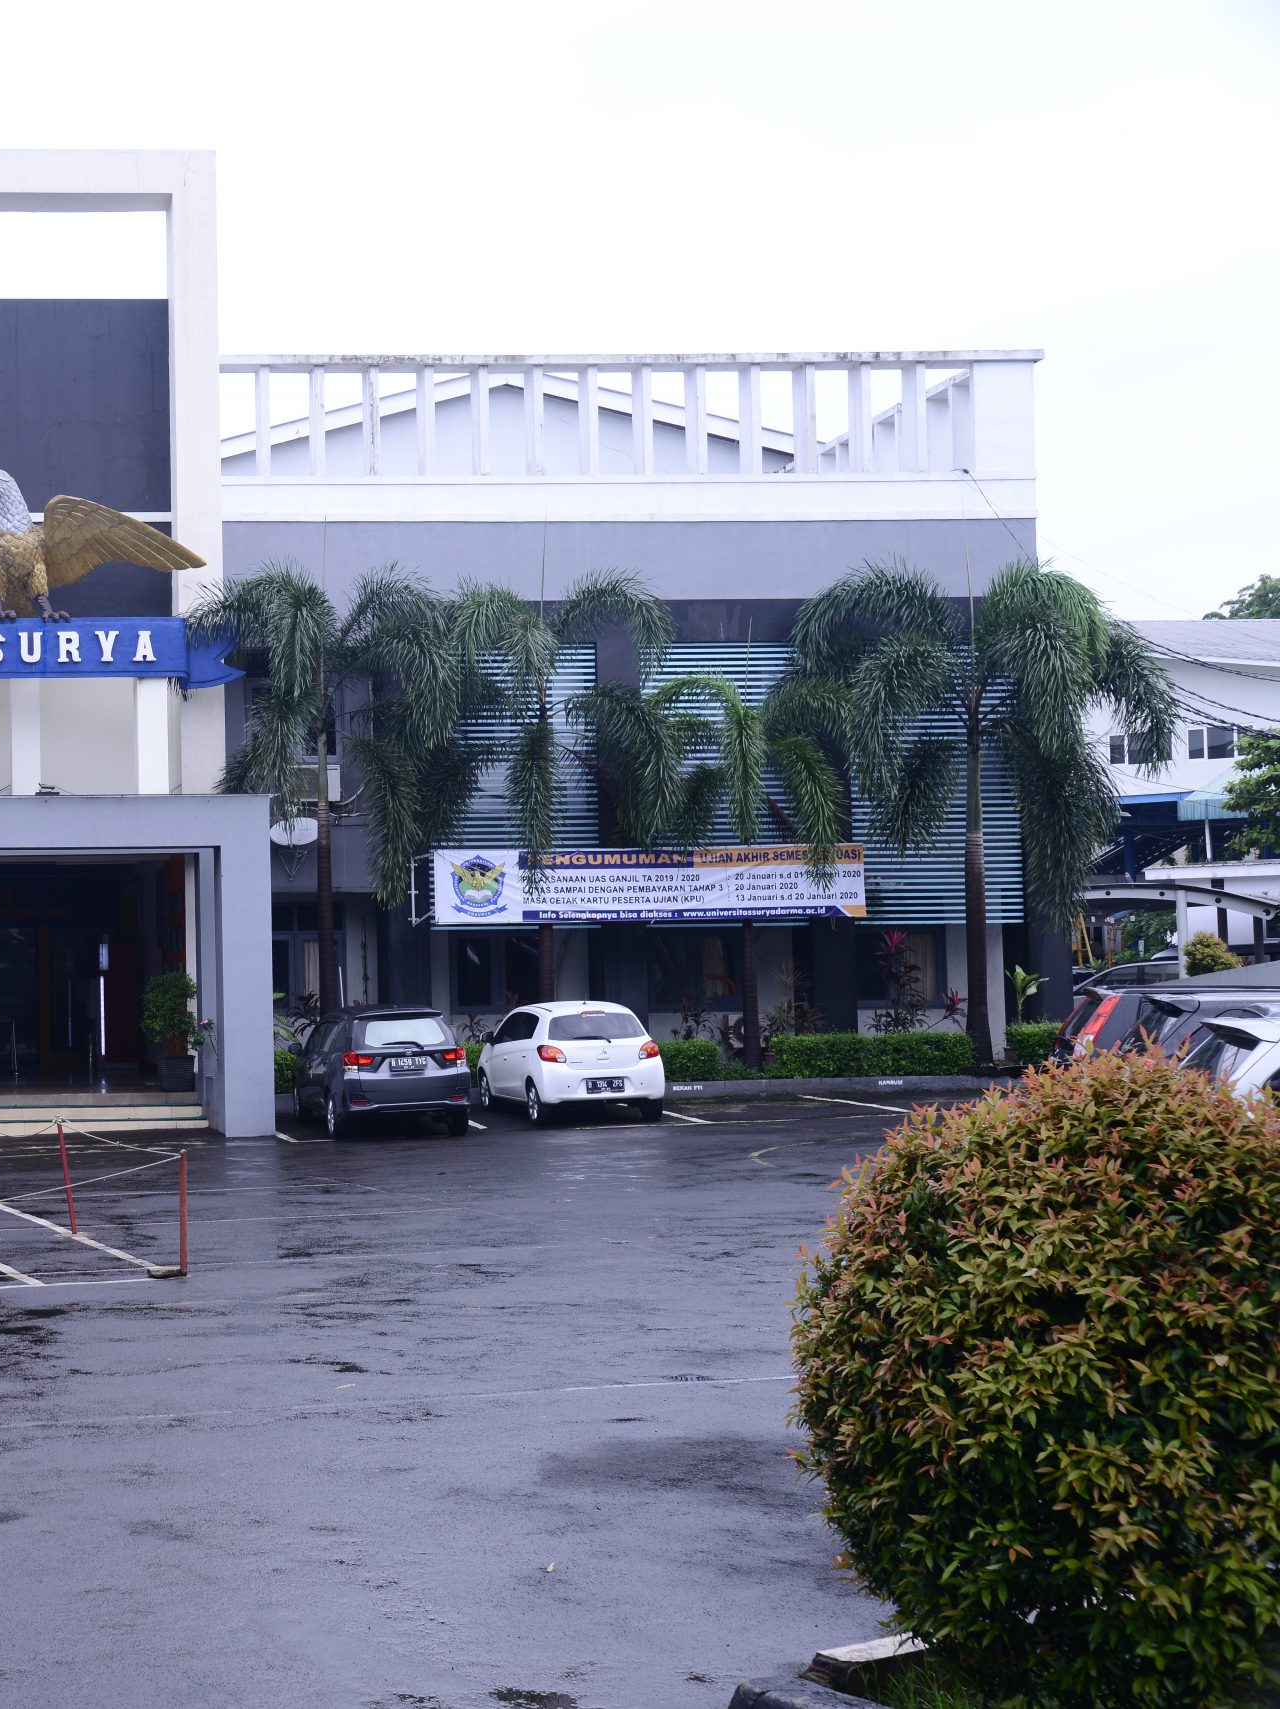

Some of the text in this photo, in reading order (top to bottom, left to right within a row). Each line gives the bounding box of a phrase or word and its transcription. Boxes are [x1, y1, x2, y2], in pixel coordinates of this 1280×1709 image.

[526, 853, 687, 865] ENGUMUMAN
[700, 853, 733, 863] UJIAN
[736, 851, 769, 863] AKHIR
[772, 849, 829, 861] SEMES
[522, 875, 587, 884] PAKSANAAN
[589, 875, 607, 883] UAS
[609, 875, 639, 883] GANJIL
[642, 874, 653, 882] TA
[655, 874, 674, 882] 2019
[681, 874, 700, 882] 2020
[735, 873, 745, 881] 20
[747, 872, 777, 880] Januari
[794, 871, 803, 879] 01
[806, 870, 839, 879] Feri
[842, 870, 861, 878] 2020
[554, 886, 586, 894] SAMPAI
[627, 885, 686, 893] PEMBAYARAN
[688, 884, 716, 892] TAHAP
[747, 883, 777, 891] Januari
[779, 882, 798, 890] 2020
[523, 897, 547, 905] MASA
[612, 896, 651, 904] PESERTA
[681, 895, 705, 904] (KPU)
[736, 894, 745, 902] 13
[748, 893, 778, 901] Januari
[780, 893, 793, 901] s.d
[807, 892, 837, 900] Januari
[558, 911, 618, 920] Selengkapnya
[620, 911, 638, 919] bisa
[682, 907, 826, 918] www.universitassuryadarma.ac.id
[391, 1059, 396, 1067] B
